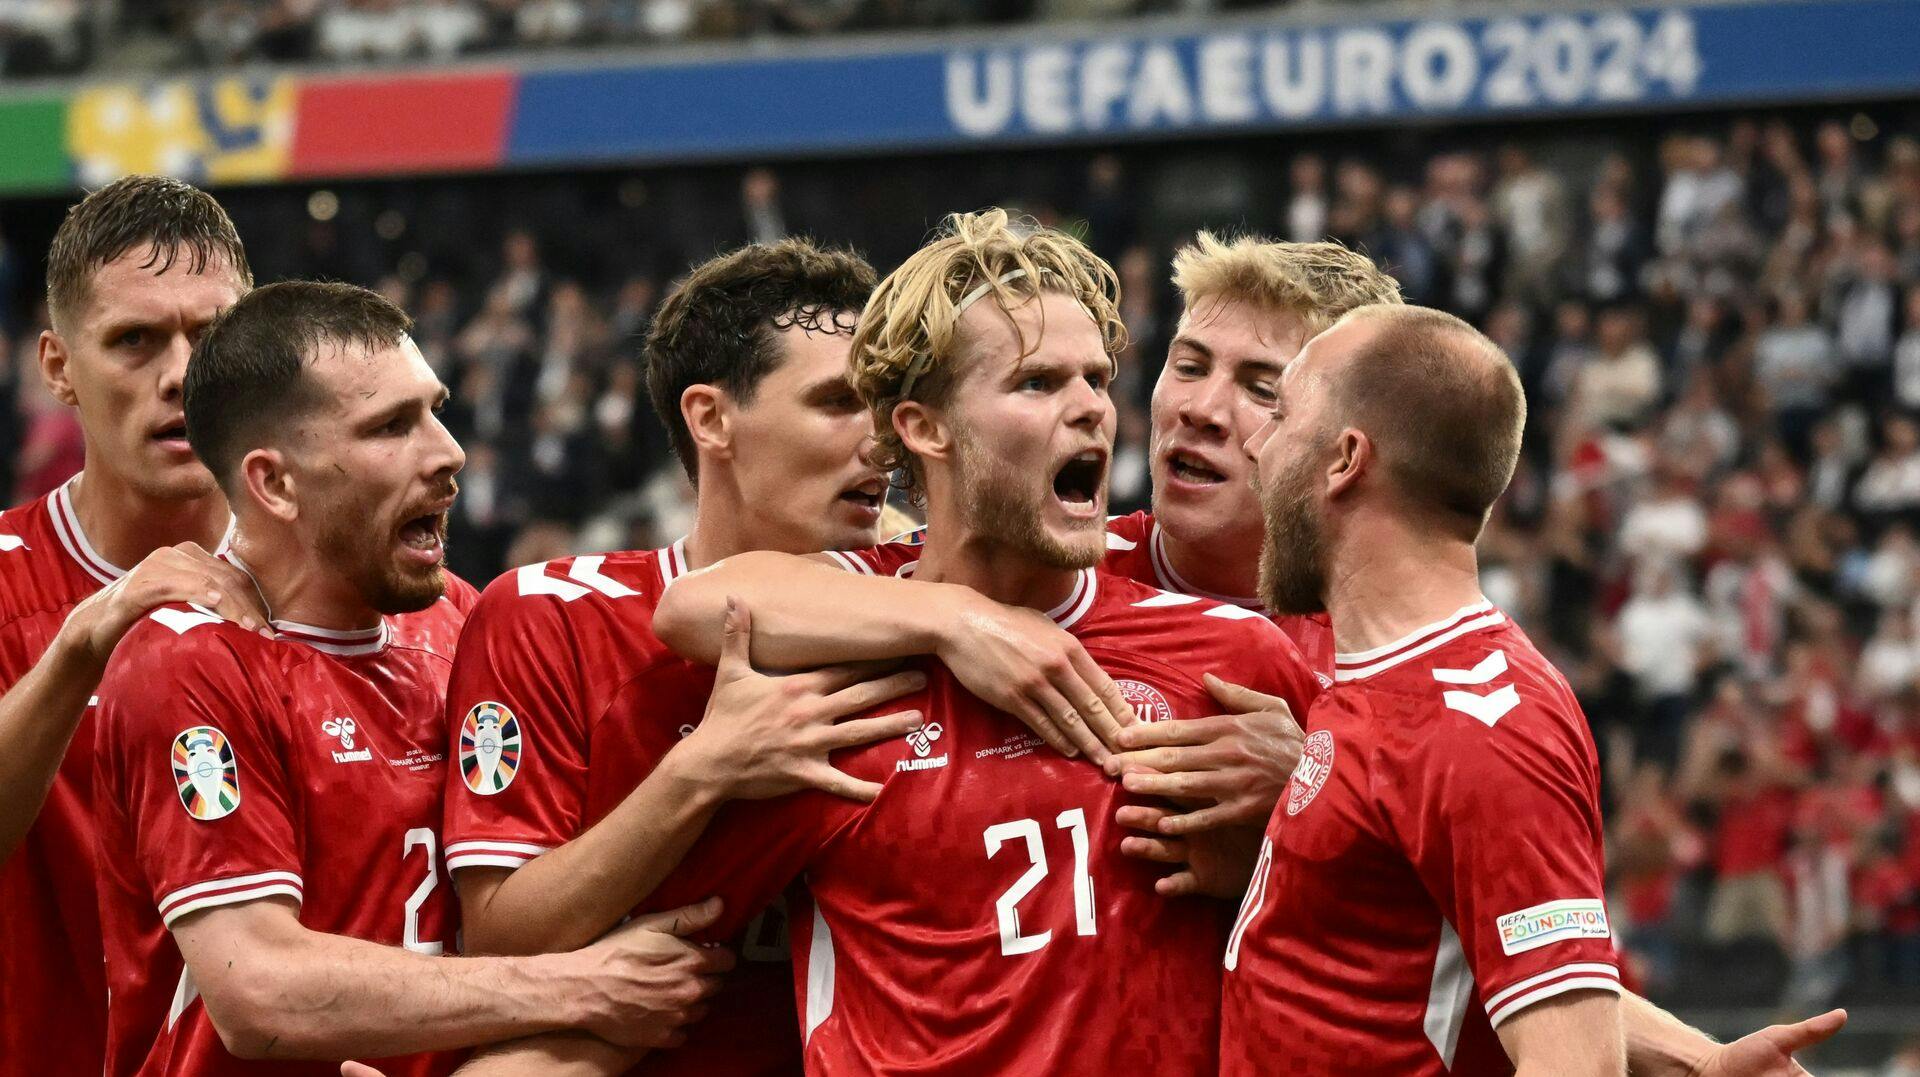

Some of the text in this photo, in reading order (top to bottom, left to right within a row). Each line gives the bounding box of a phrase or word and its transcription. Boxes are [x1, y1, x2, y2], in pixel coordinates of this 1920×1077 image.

[332, 748, 372, 763] hummel
[975, 745, 1013, 759] DENMARK
[896, 753, 948, 772] hummel
[983, 808, 1097, 956] 21
[1501, 914, 1526, 928] UEFA
[1503, 911, 1605, 942] FOUNDATION
